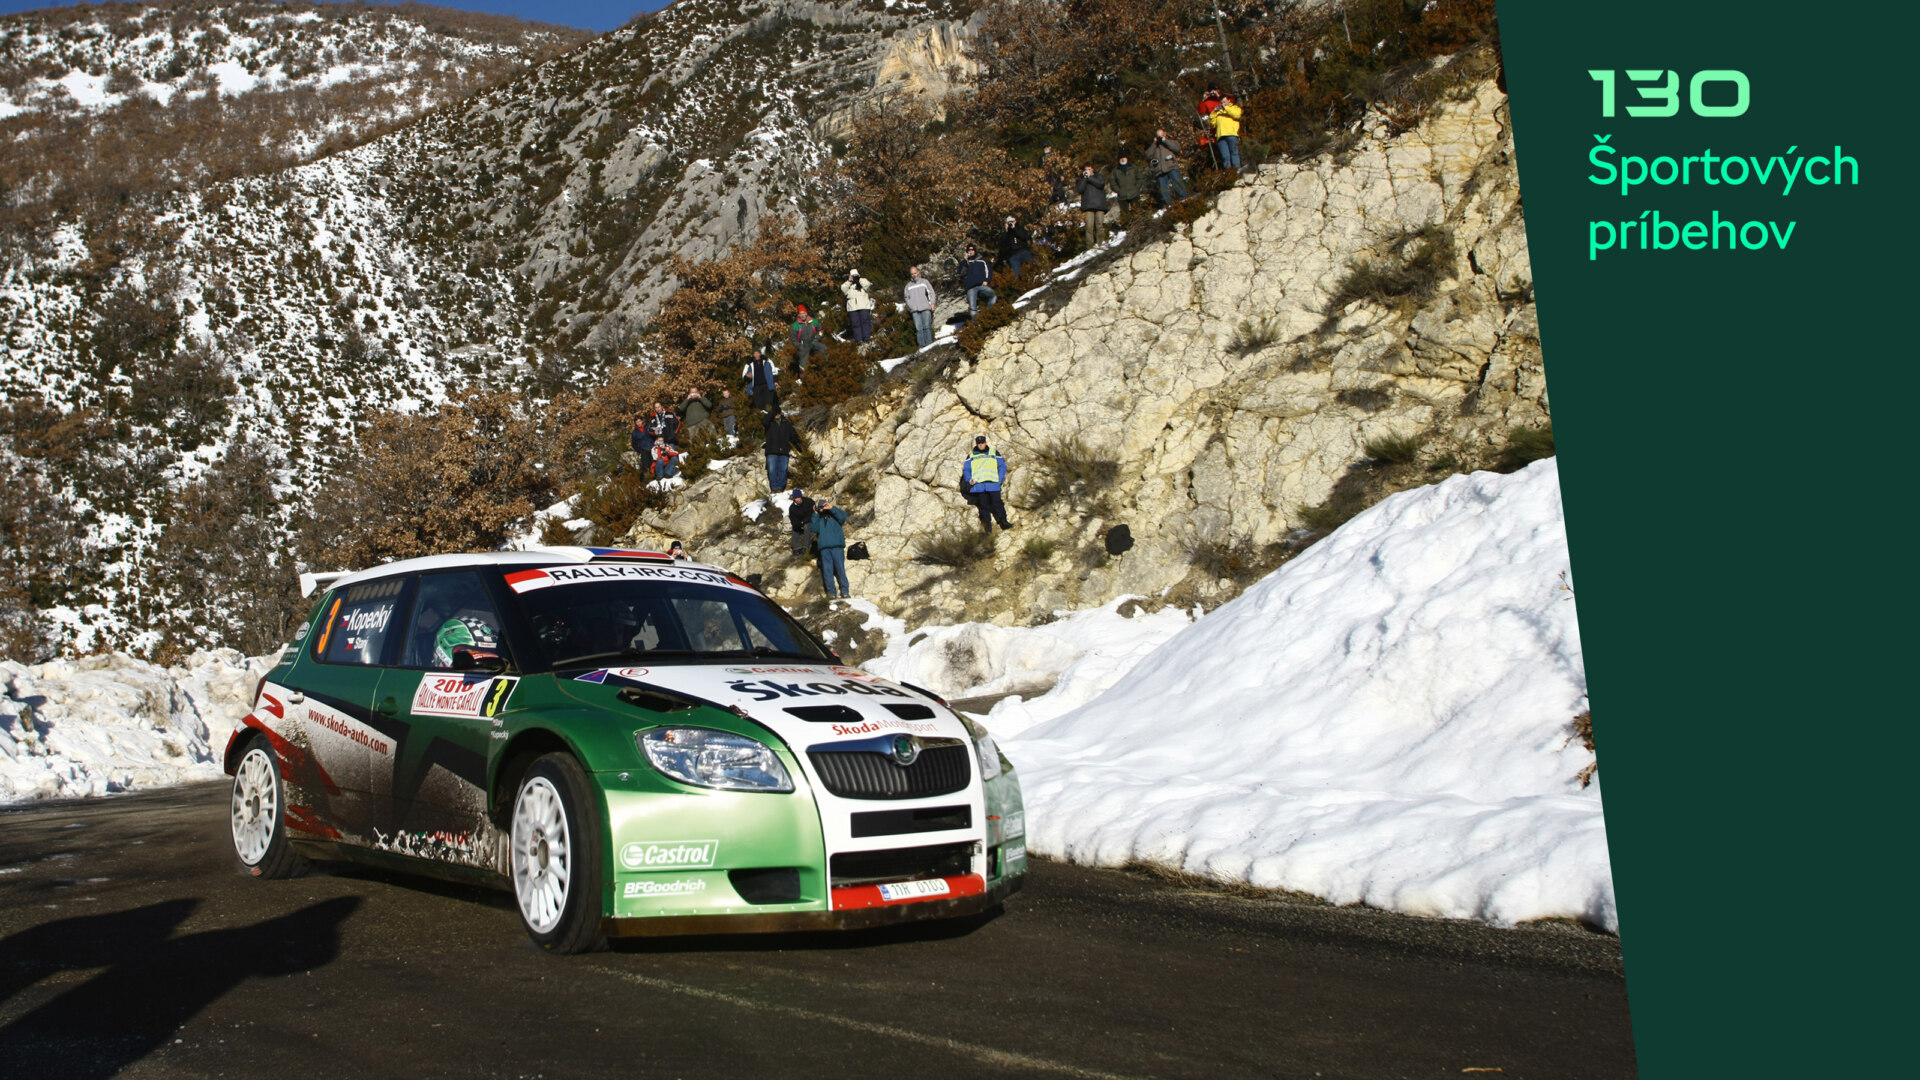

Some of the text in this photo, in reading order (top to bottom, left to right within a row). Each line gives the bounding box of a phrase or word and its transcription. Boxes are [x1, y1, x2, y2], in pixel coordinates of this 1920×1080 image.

[549, 566, 733, 587] RALLY-IRC.COM
[317, 598, 342, 655] 3
[346, 604, 394, 635] Kopecký
[434, 679, 475, 694] 2010
[486, 678, 508, 718] 3
[723, 679, 914, 702] Škoda
[308, 708, 388, 755] www.skoda-auto.com
[645, 844, 710, 865] Castrol
[623, 879, 707, 895] BFGoodrich
